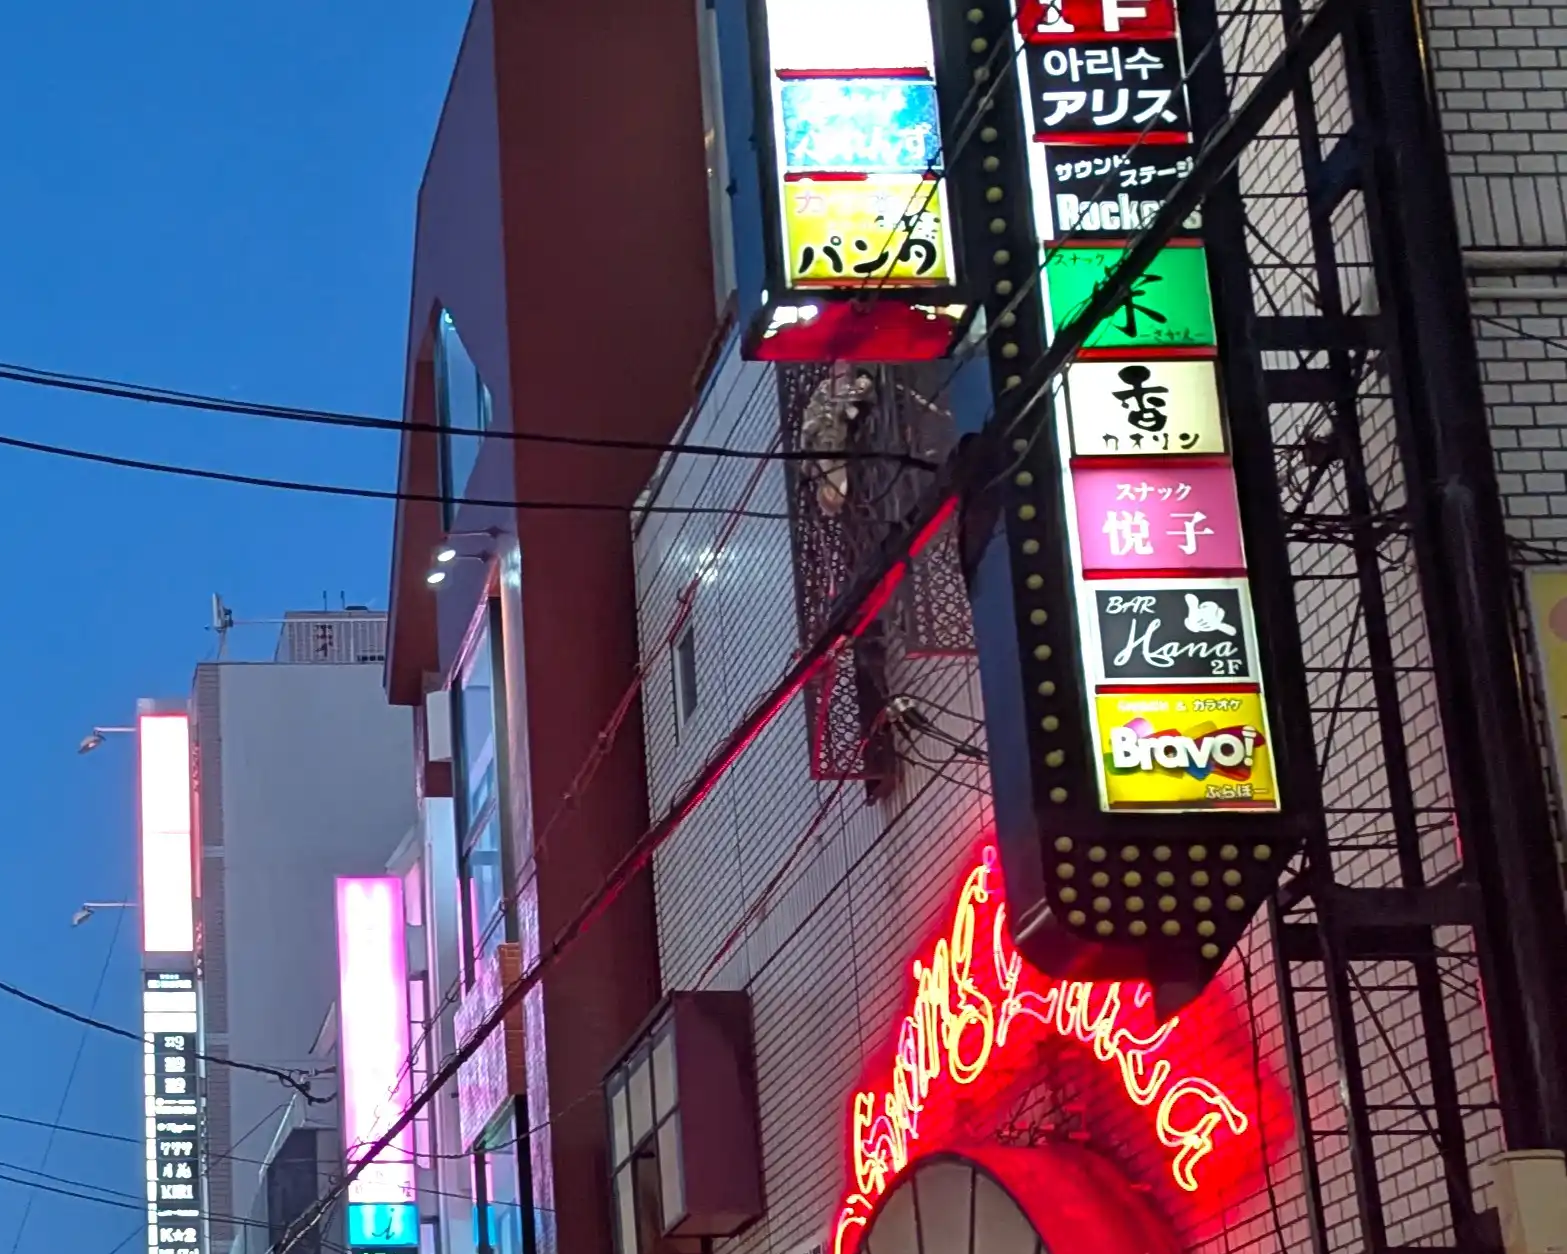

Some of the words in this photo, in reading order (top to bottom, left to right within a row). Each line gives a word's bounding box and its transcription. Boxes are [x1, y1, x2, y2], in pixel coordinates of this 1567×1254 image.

[1043, 47, 1164, 82] 아리수
[1042, 89, 1178, 126] アリス
[1055, 154, 1131, 182] サウンド
[1119, 156, 1195, 188] ステージ
[1056, 192, 1203, 231] Rockes
[1054, 253, 1106, 268] スナック
[1111, 365, 1170, 433] 香
[1102, 432, 1200, 451] カオリン
[1116, 483, 1193, 501] スナック
[1102, 509, 1215, 556] 悦子
[1105, 595, 1157, 615] BAR
[1113, 617, 1239, 668] Hana
[1211, 658, 1243, 676] 2F
[1110, 725, 1257, 772] Bravo!
